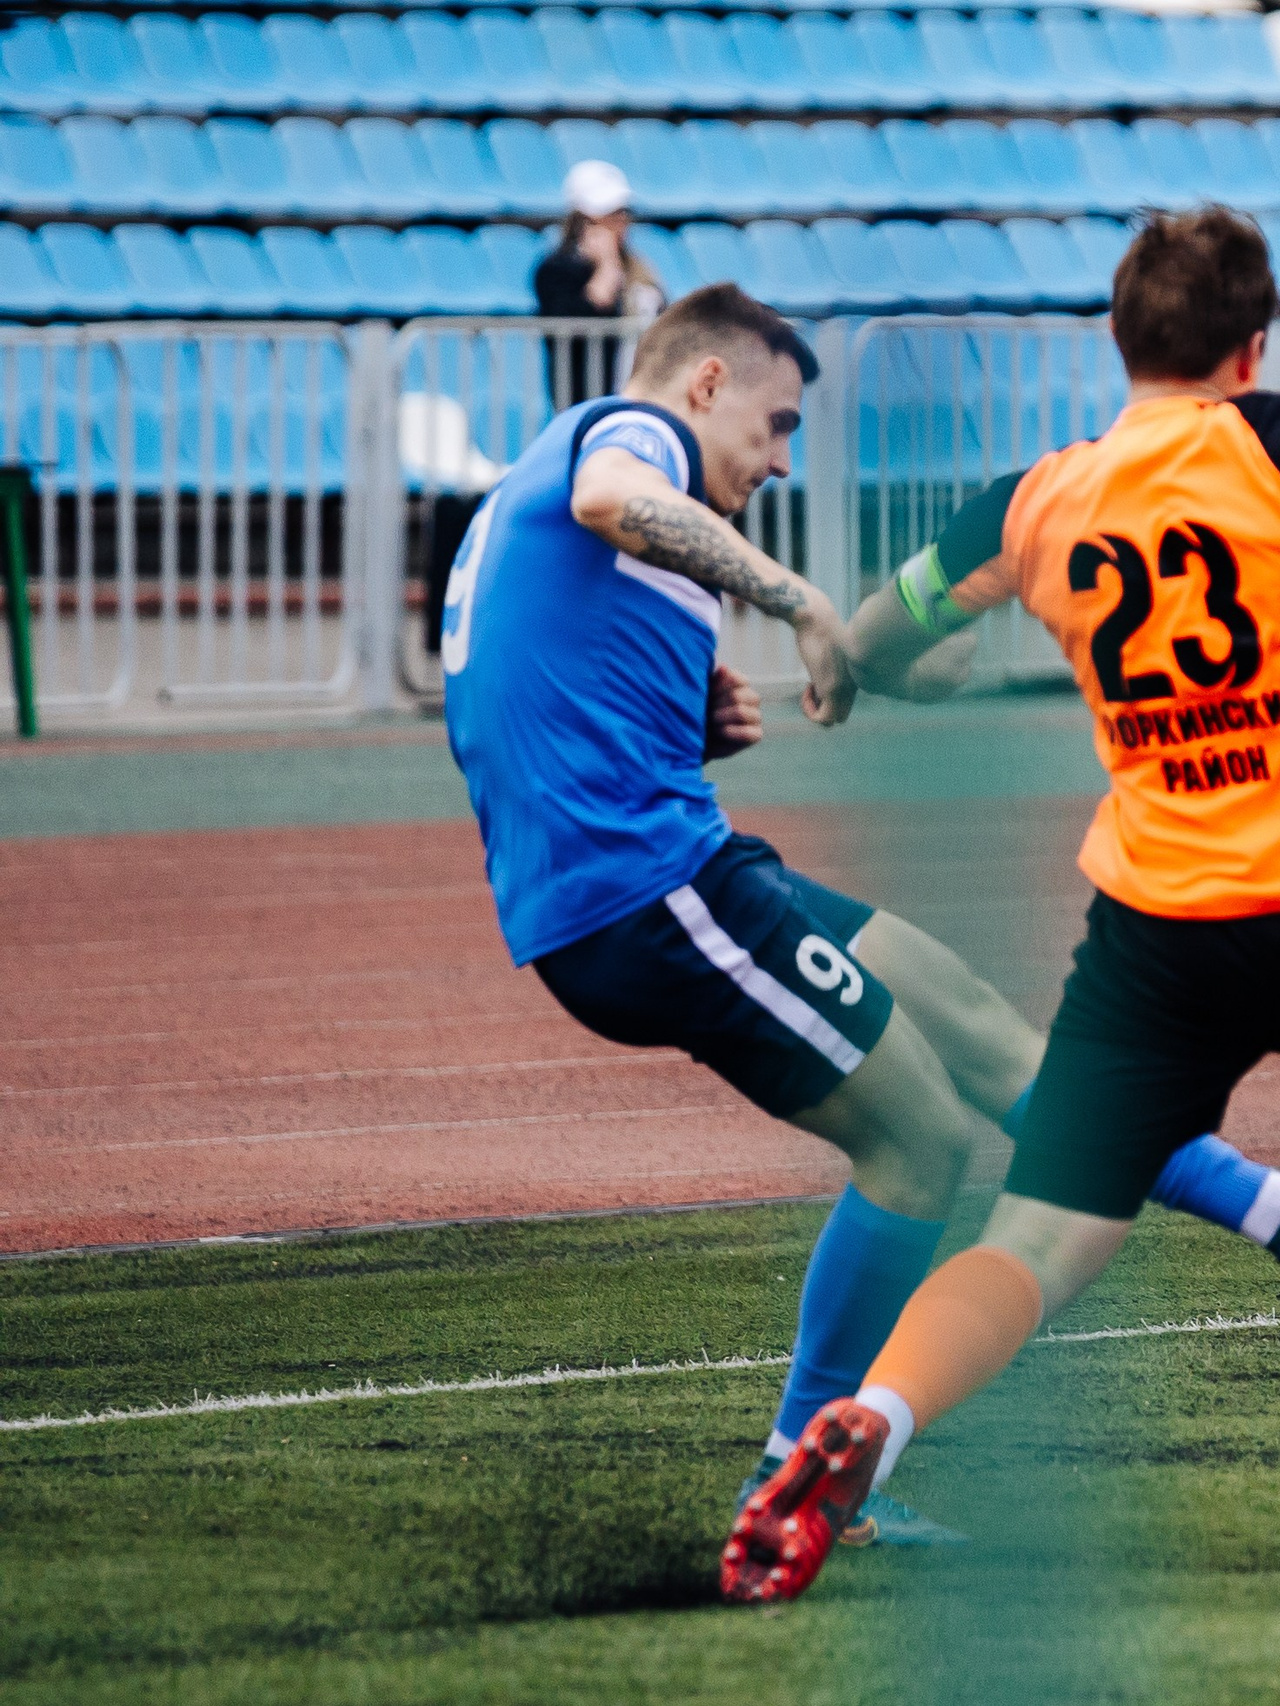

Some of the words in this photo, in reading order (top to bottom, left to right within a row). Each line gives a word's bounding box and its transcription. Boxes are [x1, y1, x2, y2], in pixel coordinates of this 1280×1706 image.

[1067, 520, 1264, 702] 23
[1161, 745, 1270, 793] РАЙОН
[795, 933, 864, 1006] 9
